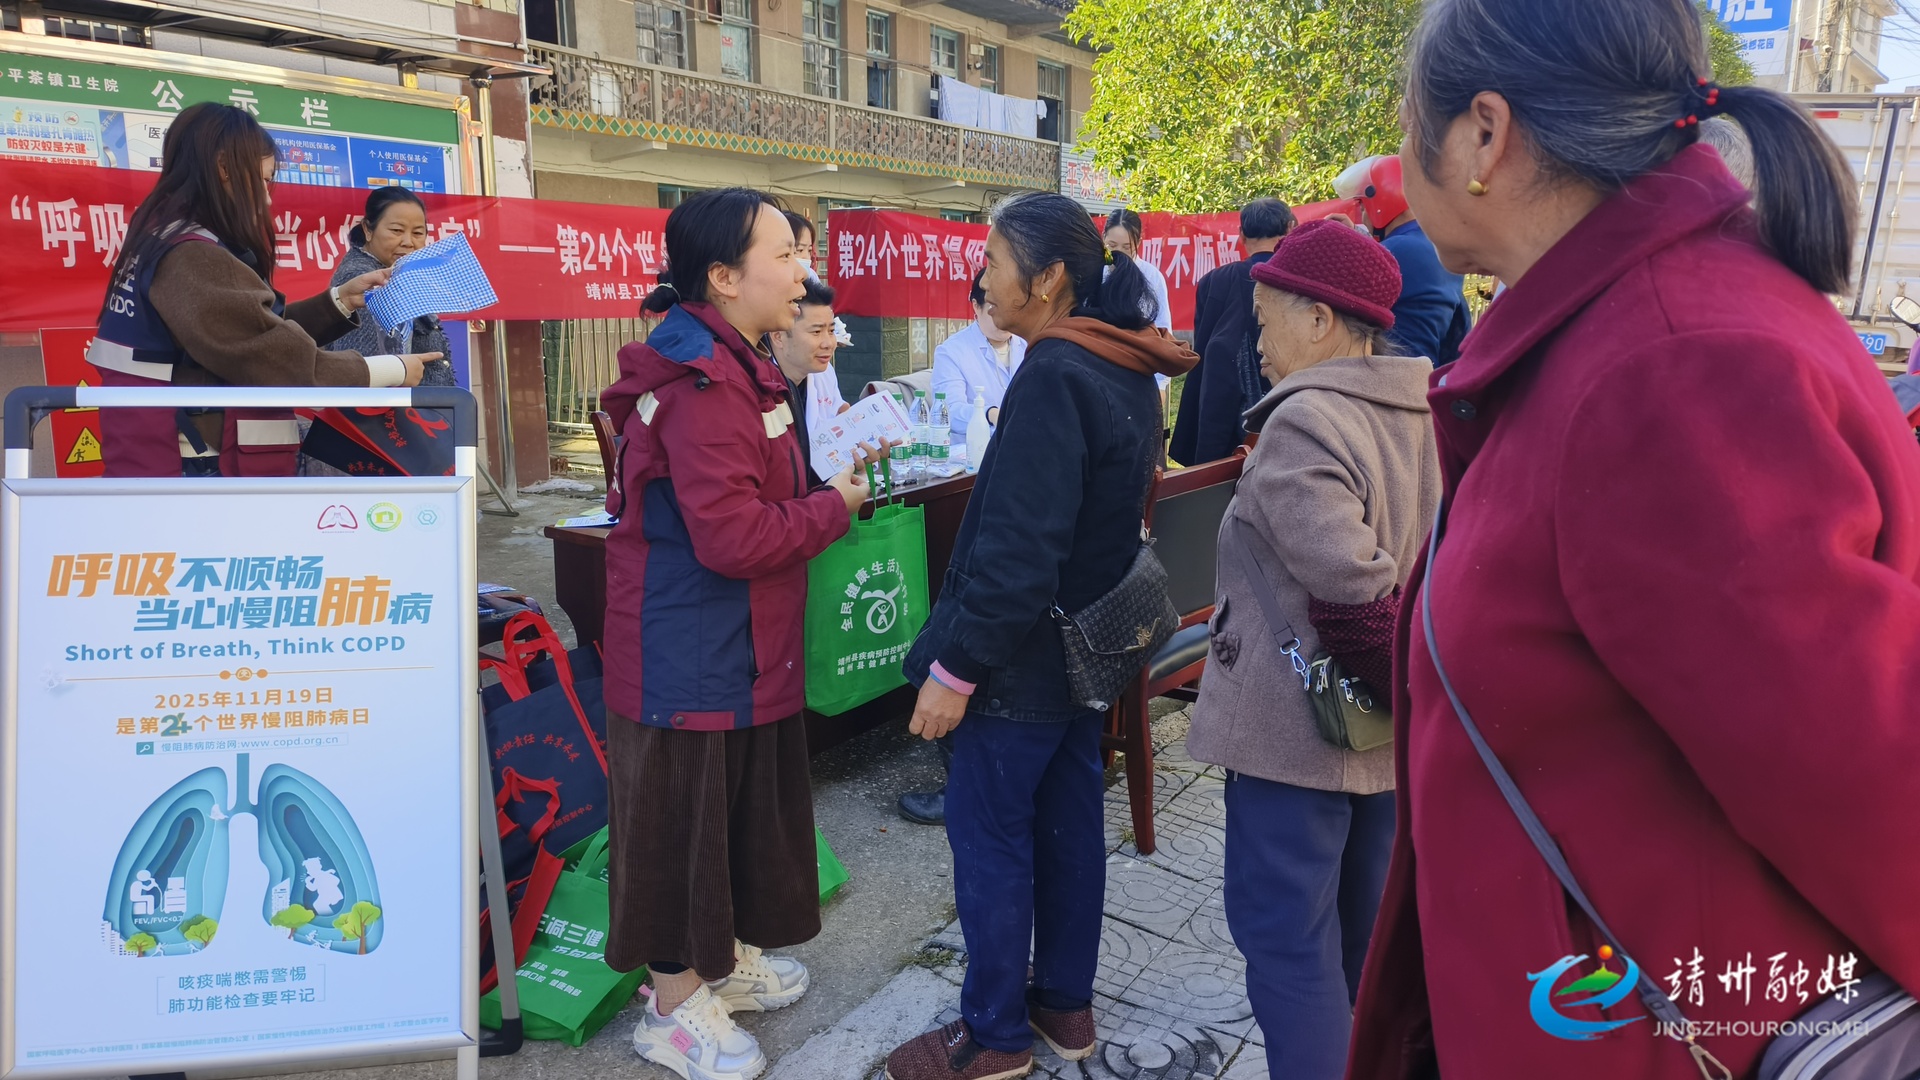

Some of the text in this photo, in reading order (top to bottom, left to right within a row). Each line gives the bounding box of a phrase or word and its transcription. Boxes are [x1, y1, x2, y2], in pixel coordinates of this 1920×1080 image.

[8, 68, 119, 92] 平茶镇卫生院
[151, 79, 331, 127] 公示栏
[28, 112, 59, 123] 预防
[7, 138, 86, 154] 防蚊灭蚊是关键
[274, 138, 337, 151] 药机构使用医保基金
[369, 150, 428, 163] 个人使用医保基金
[46, 552, 324, 597] 呼吸不顺畅
[133, 575, 434, 631] 当心慢阻肺病
[65, 635, 406, 662] Short of Breath, Think COPD
[154, 687, 334, 710] 2025年11月19日
[116, 707, 370, 738] 是第24个世界慢阻肺病日
[178, 965, 307, 991] 咳痰喘憋需警惕
[168, 987, 316, 1014] 肺功能检查要牢记
